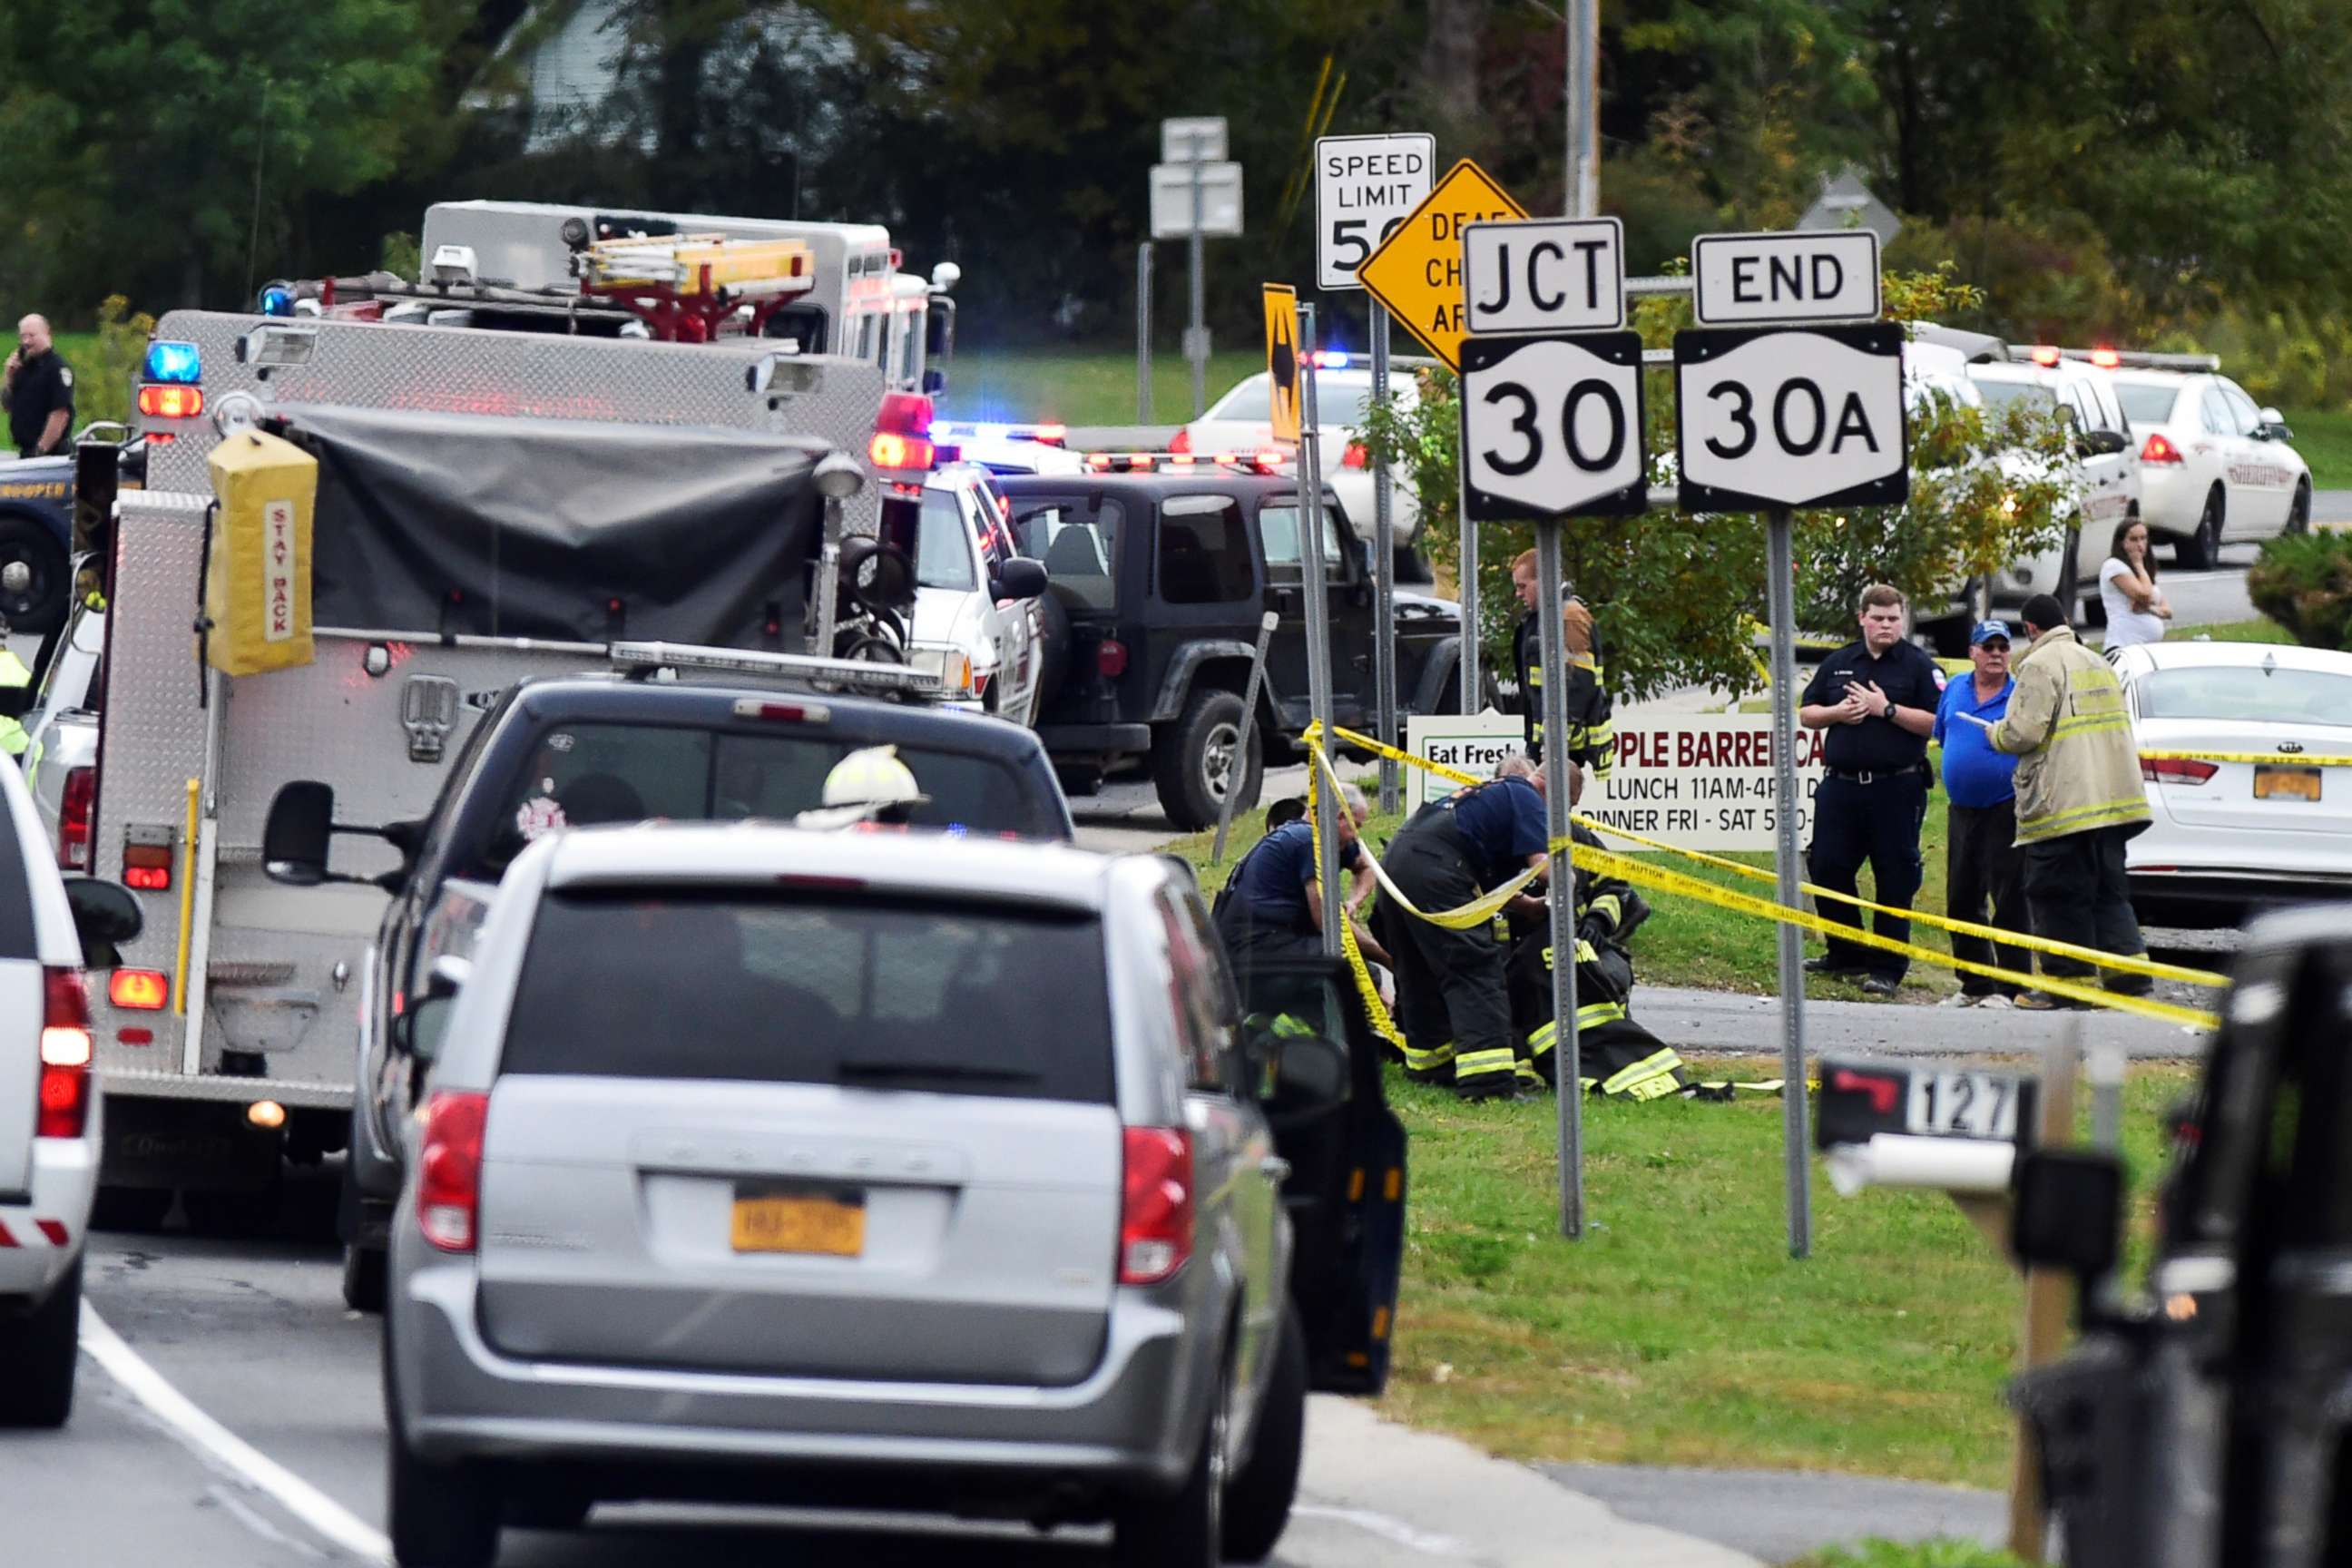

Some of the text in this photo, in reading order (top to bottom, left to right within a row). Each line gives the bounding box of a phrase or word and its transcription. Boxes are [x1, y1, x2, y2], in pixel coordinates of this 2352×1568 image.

[1328, 153, 1423, 178] SPEED
[1338, 184, 1412, 207] LIMIT
[1426, 259, 1462, 288] CH
[1476, 240, 1608, 314] JCT
[1731, 253, 1844, 303] END
[1482, 377, 1625, 476] 30
[1705, 377, 1879, 458] 30A
[272, 509, 287, 632] STAY BACK
[1428, 745, 1458, 764] Eat
[1795, 730, 1827, 768] CA
[1606, 778, 1678, 799] LUNCH
[1667, 809, 1698, 831] FRI
[1720, 808, 1757, 831] SAT
[1623, 861, 1665, 880] CAUTION
[1924, 1073, 2008, 1132] 127
